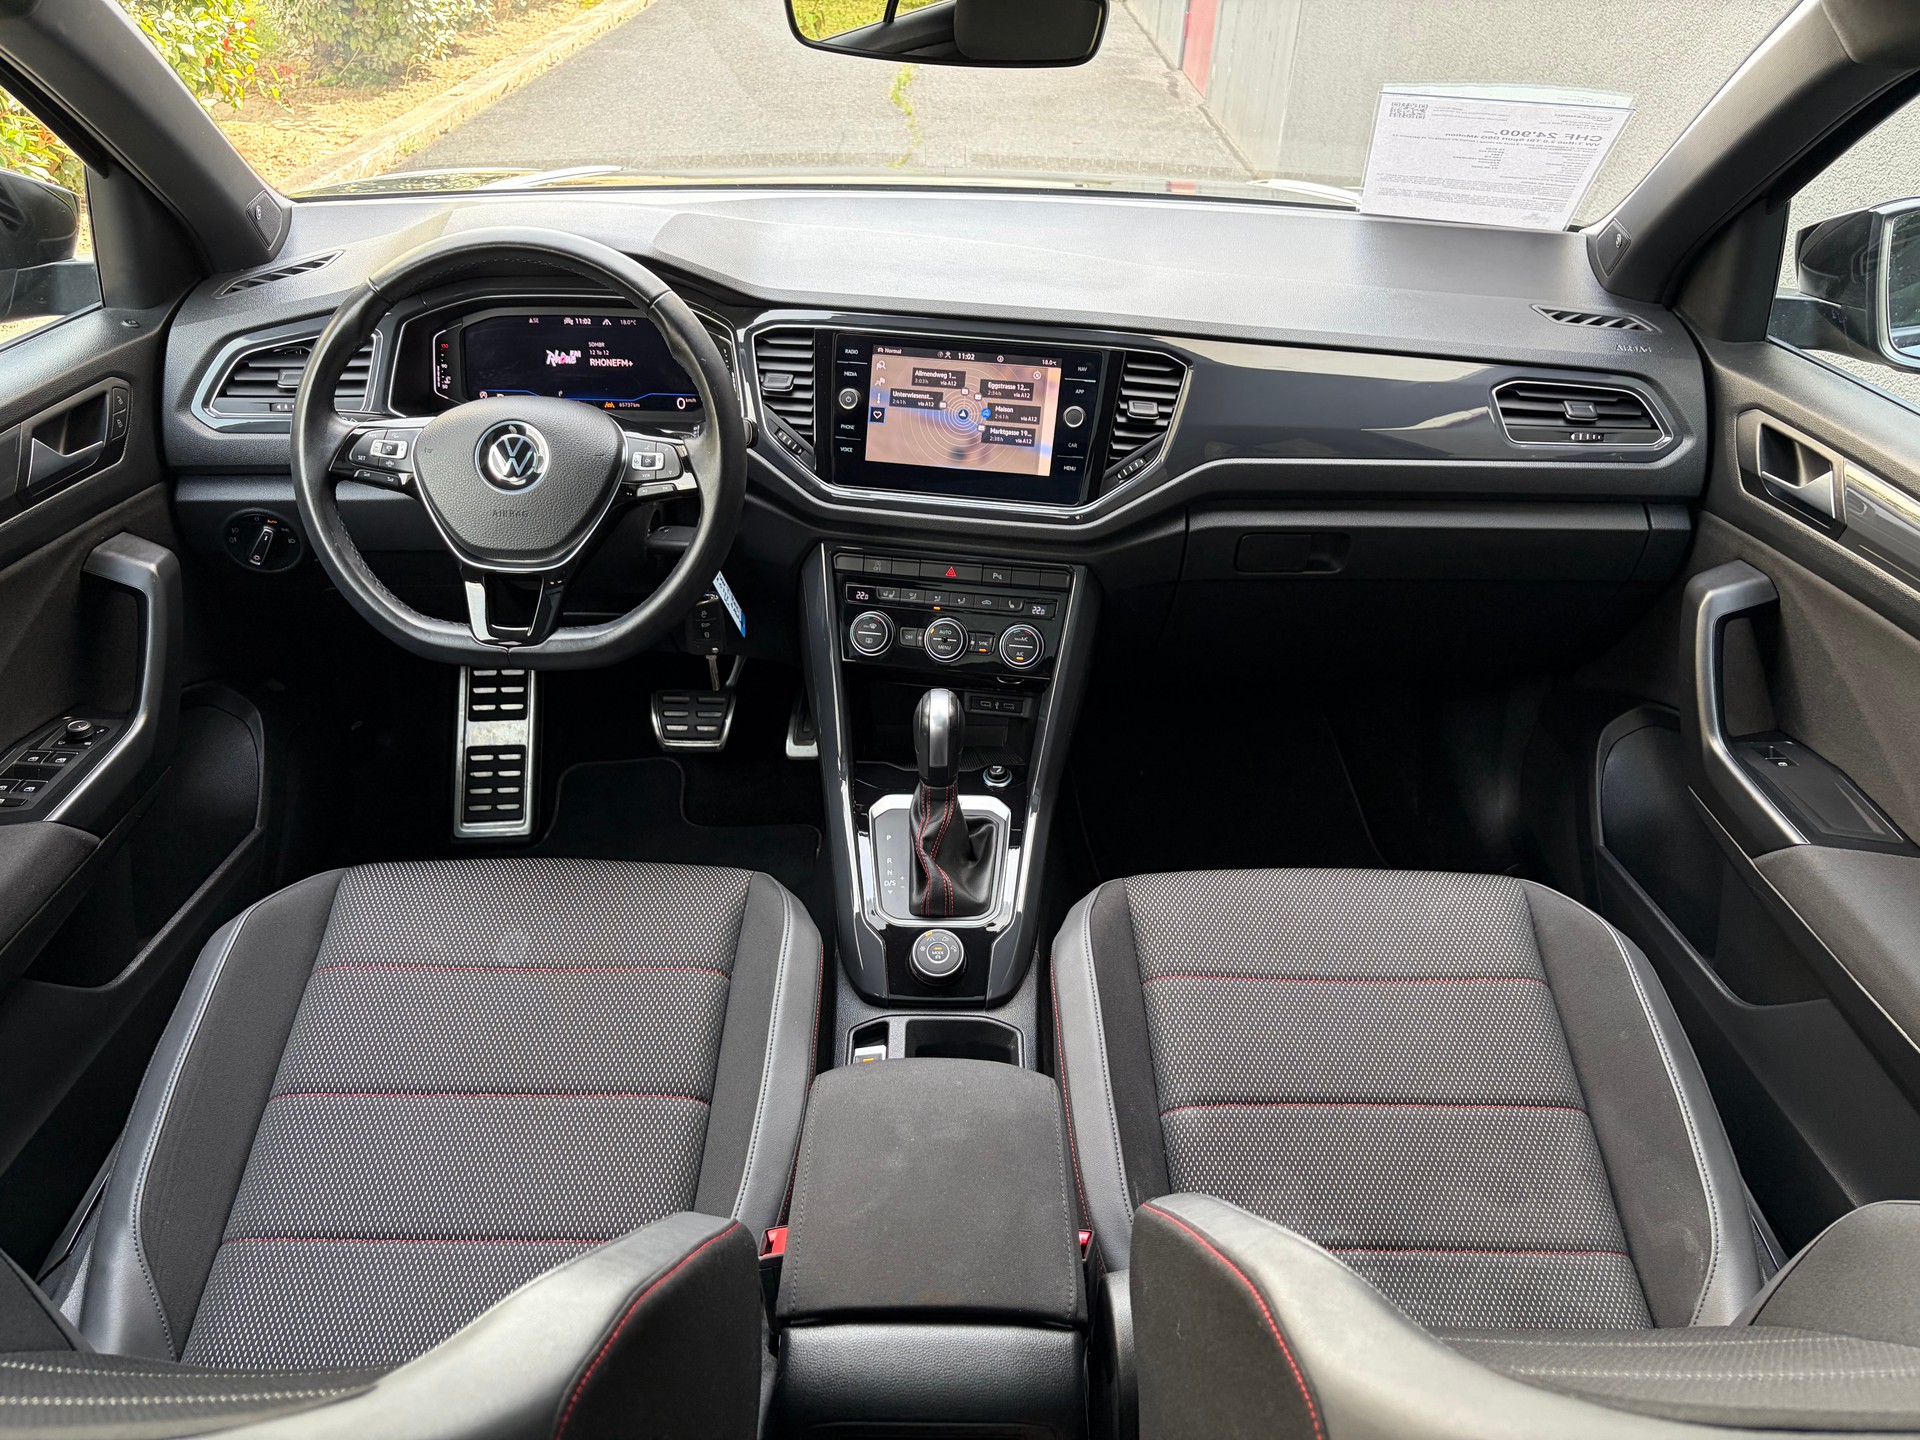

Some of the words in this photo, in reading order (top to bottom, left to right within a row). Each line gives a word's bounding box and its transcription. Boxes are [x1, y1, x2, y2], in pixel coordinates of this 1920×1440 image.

[575, 317, 592, 325] 11:02
[957, 352, 975, 361] 11:02
[589, 357, 634, 368] RHONEFM+
[843, 370, 858, 378] MEDIA
[914, 370, 948, 380] Allmendweg
[987, 381, 1016, 391] Eggstrasse
[676, 397, 686, 410] 0
[994, 405, 1014, 414] Maison
[840, 423, 855, 431] PHONE
[989, 427, 1020, 438] Marktgasse
[1063, 464, 1077, 472] MENU
[492, 509, 528, 518] AIRBAG
[856, 591, 869, 600] 22.0
[1031, 606, 1046, 615] 22.0
[883, 880, 897, 888] D/S
